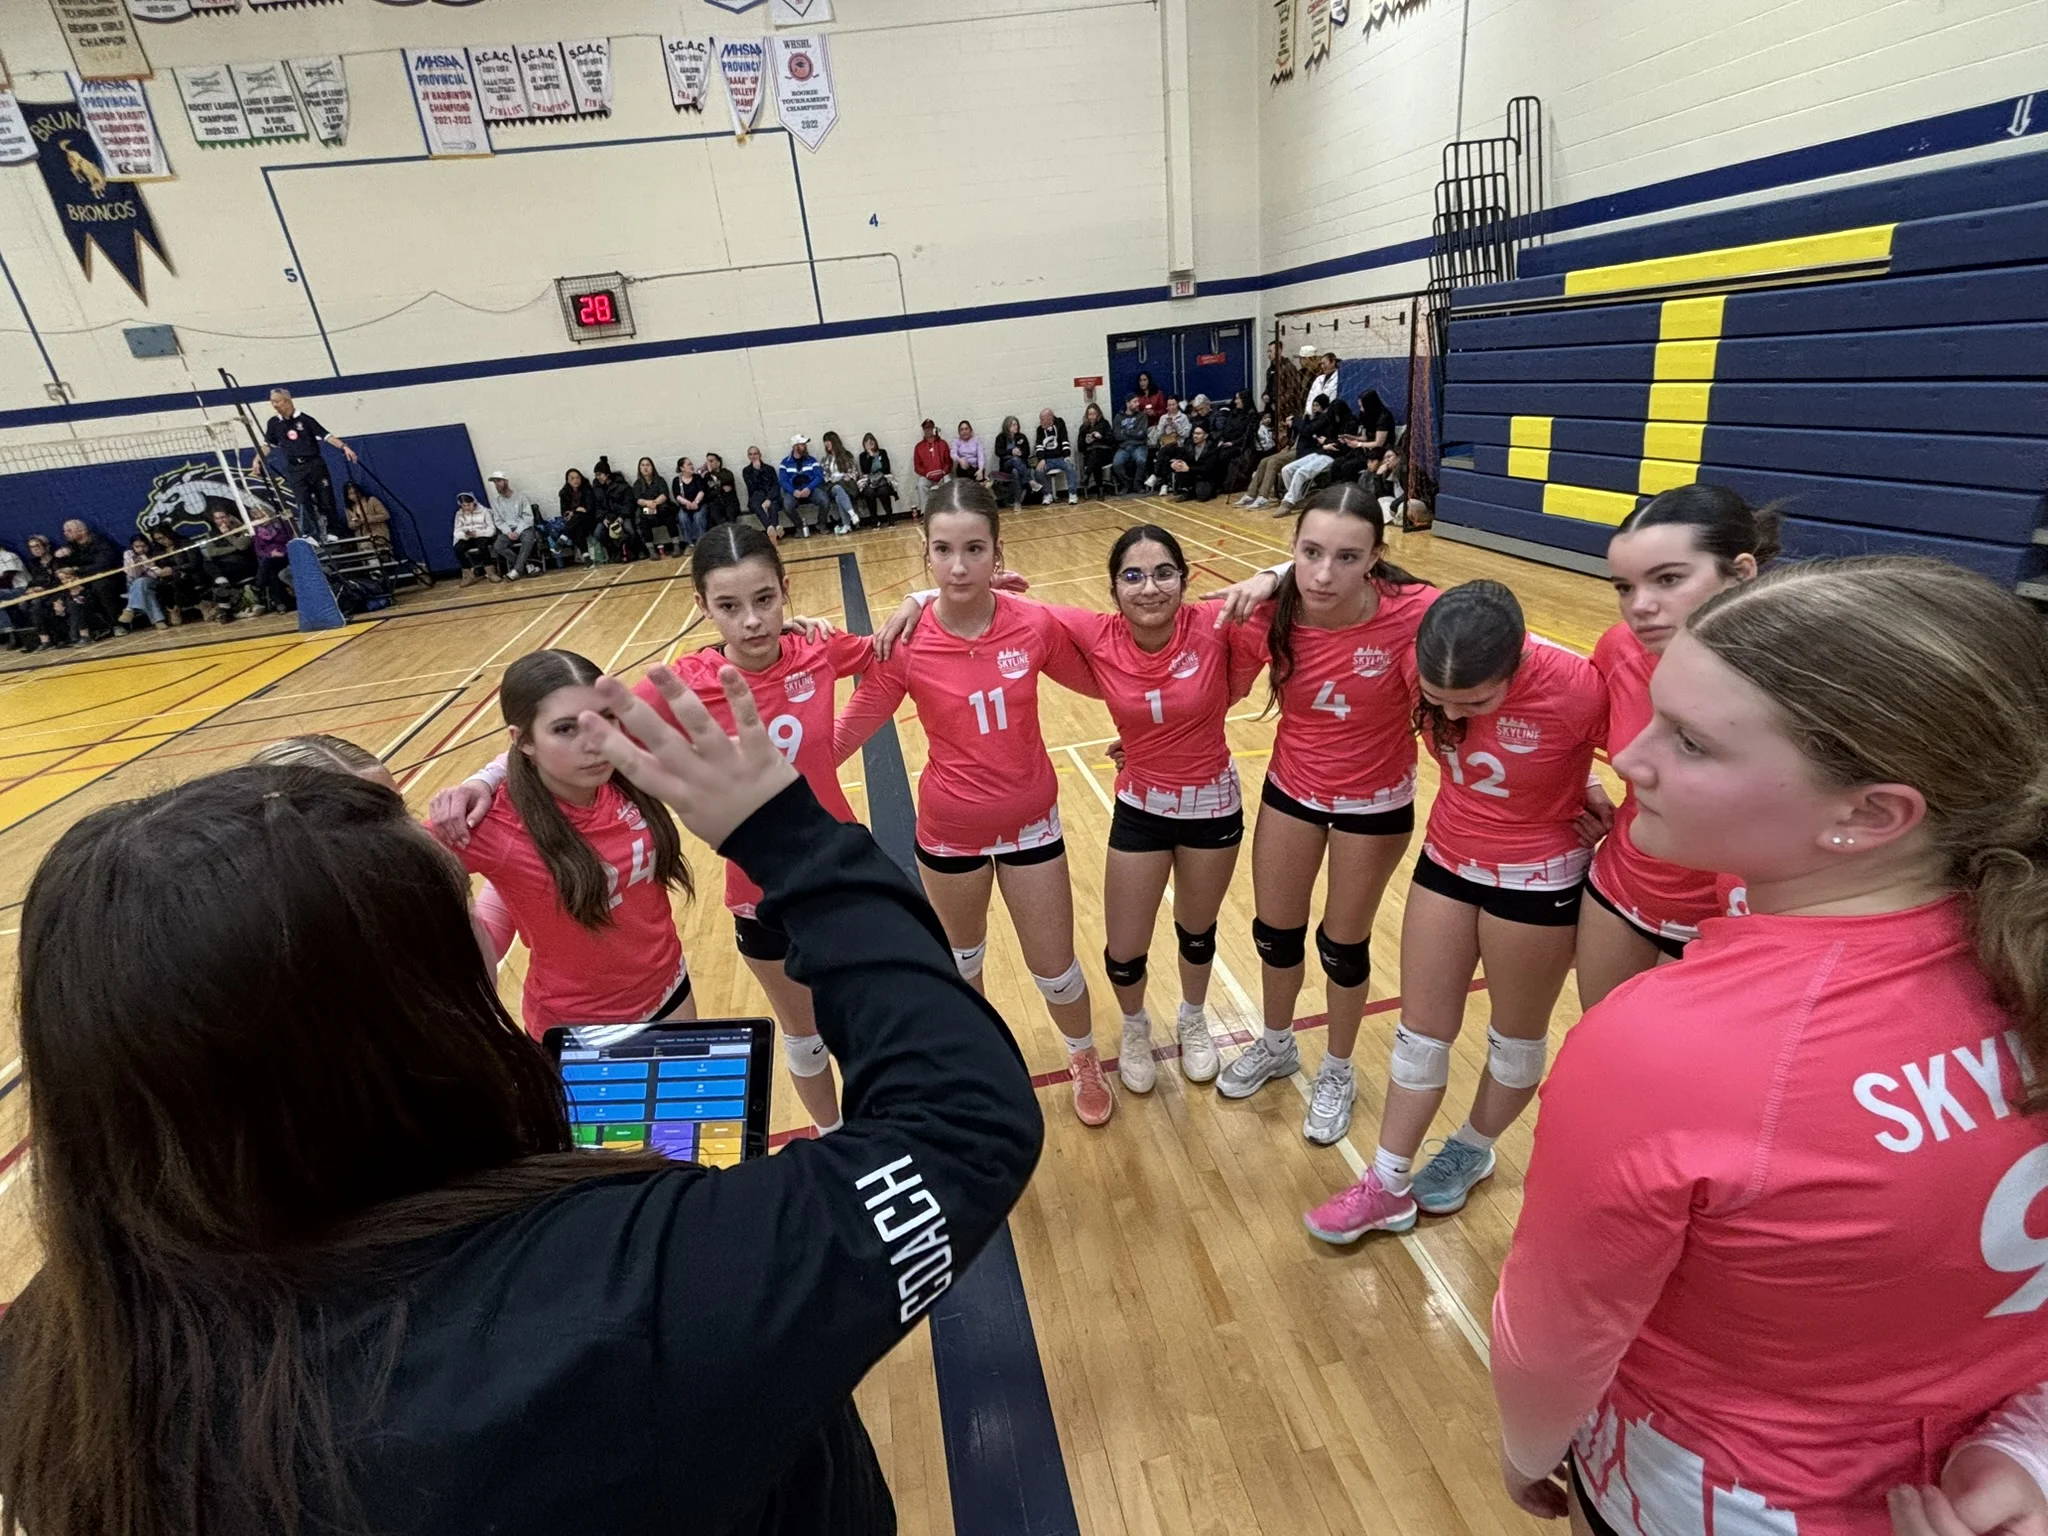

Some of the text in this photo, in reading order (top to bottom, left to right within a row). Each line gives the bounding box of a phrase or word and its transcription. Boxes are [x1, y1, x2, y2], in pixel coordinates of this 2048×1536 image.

[415, 55, 464, 71] MHSAA
[417, 73, 467, 86] PROVINCIAL
[83, 95, 141, 108] PROVINCIAL
[429, 102, 470, 113] CHAMPIONS
[782, 96, 830, 105] TOURNAMENT
[30, 111, 86, 142] BRUN
[66, 200, 137, 221] BRONCOS
[283, 267, 298, 283] 5
[1176, 281, 1190, 294] EXIT
[997, 653, 1030, 671] SKYLINE
[1145, 688, 1164, 724] 1
[1311, 680, 1351, 721] 4
[968, 686, 1008, 735] 11
[768, 714, 804, 764] 9
[1496, 725, 1542, 740] SKYLINE
[1441, 745, 1510, 798] 12
[855, 1154, 953, 1324] COACH
